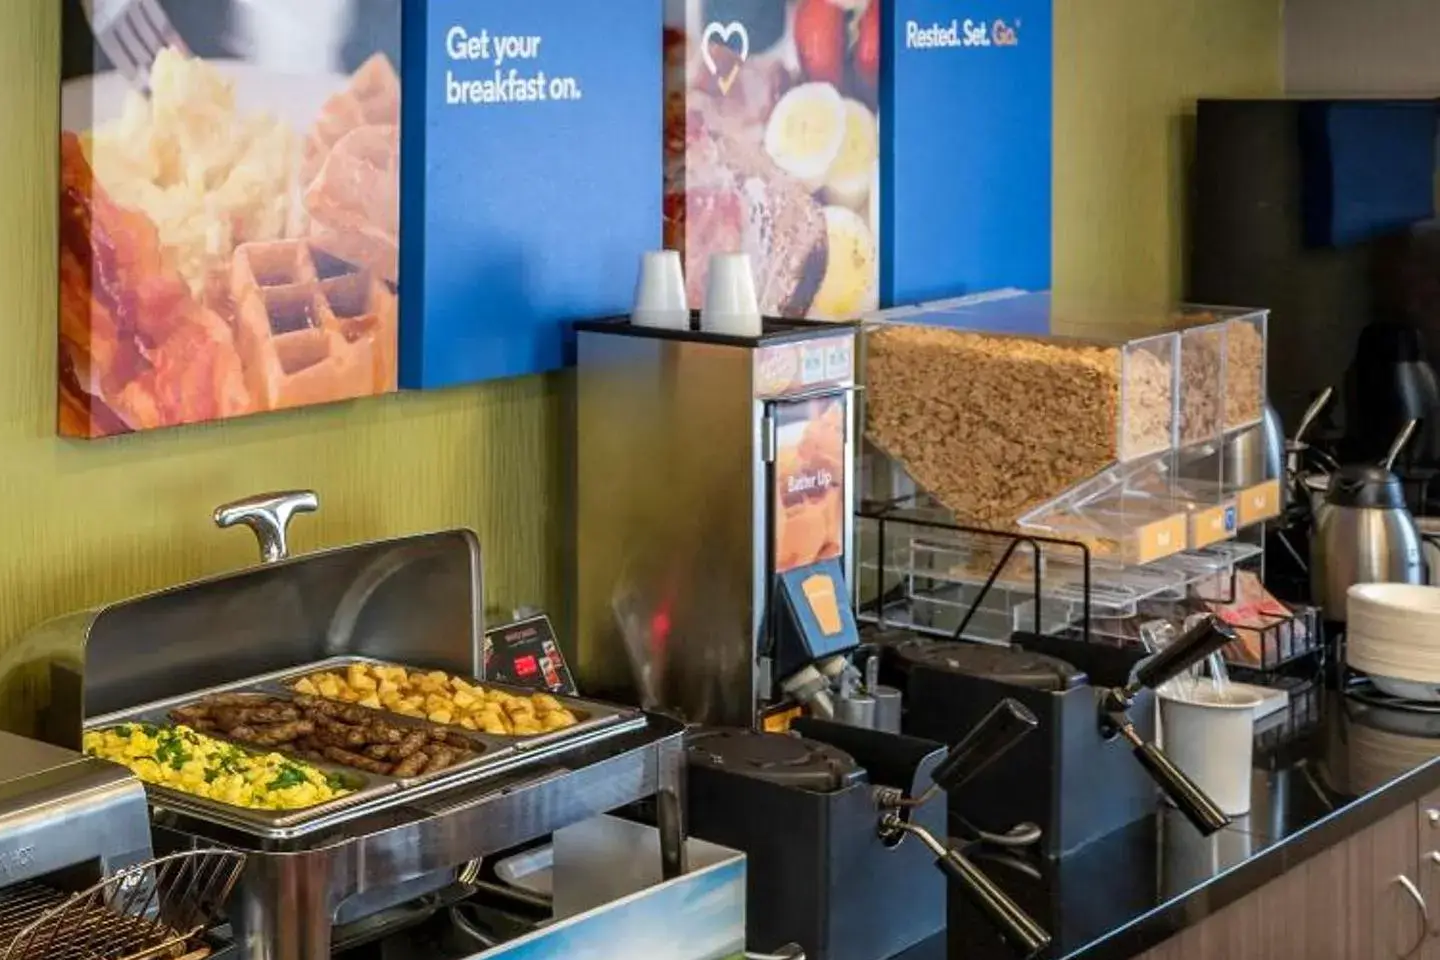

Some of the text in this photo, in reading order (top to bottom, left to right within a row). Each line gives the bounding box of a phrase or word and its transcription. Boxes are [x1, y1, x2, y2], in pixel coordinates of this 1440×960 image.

[446, 25, 541, 66] Get your
[906, 19, 961, 49] Rested.
[963, 18, 991, 46] Set.
[446, 68, 582, 104] breakfast on.
